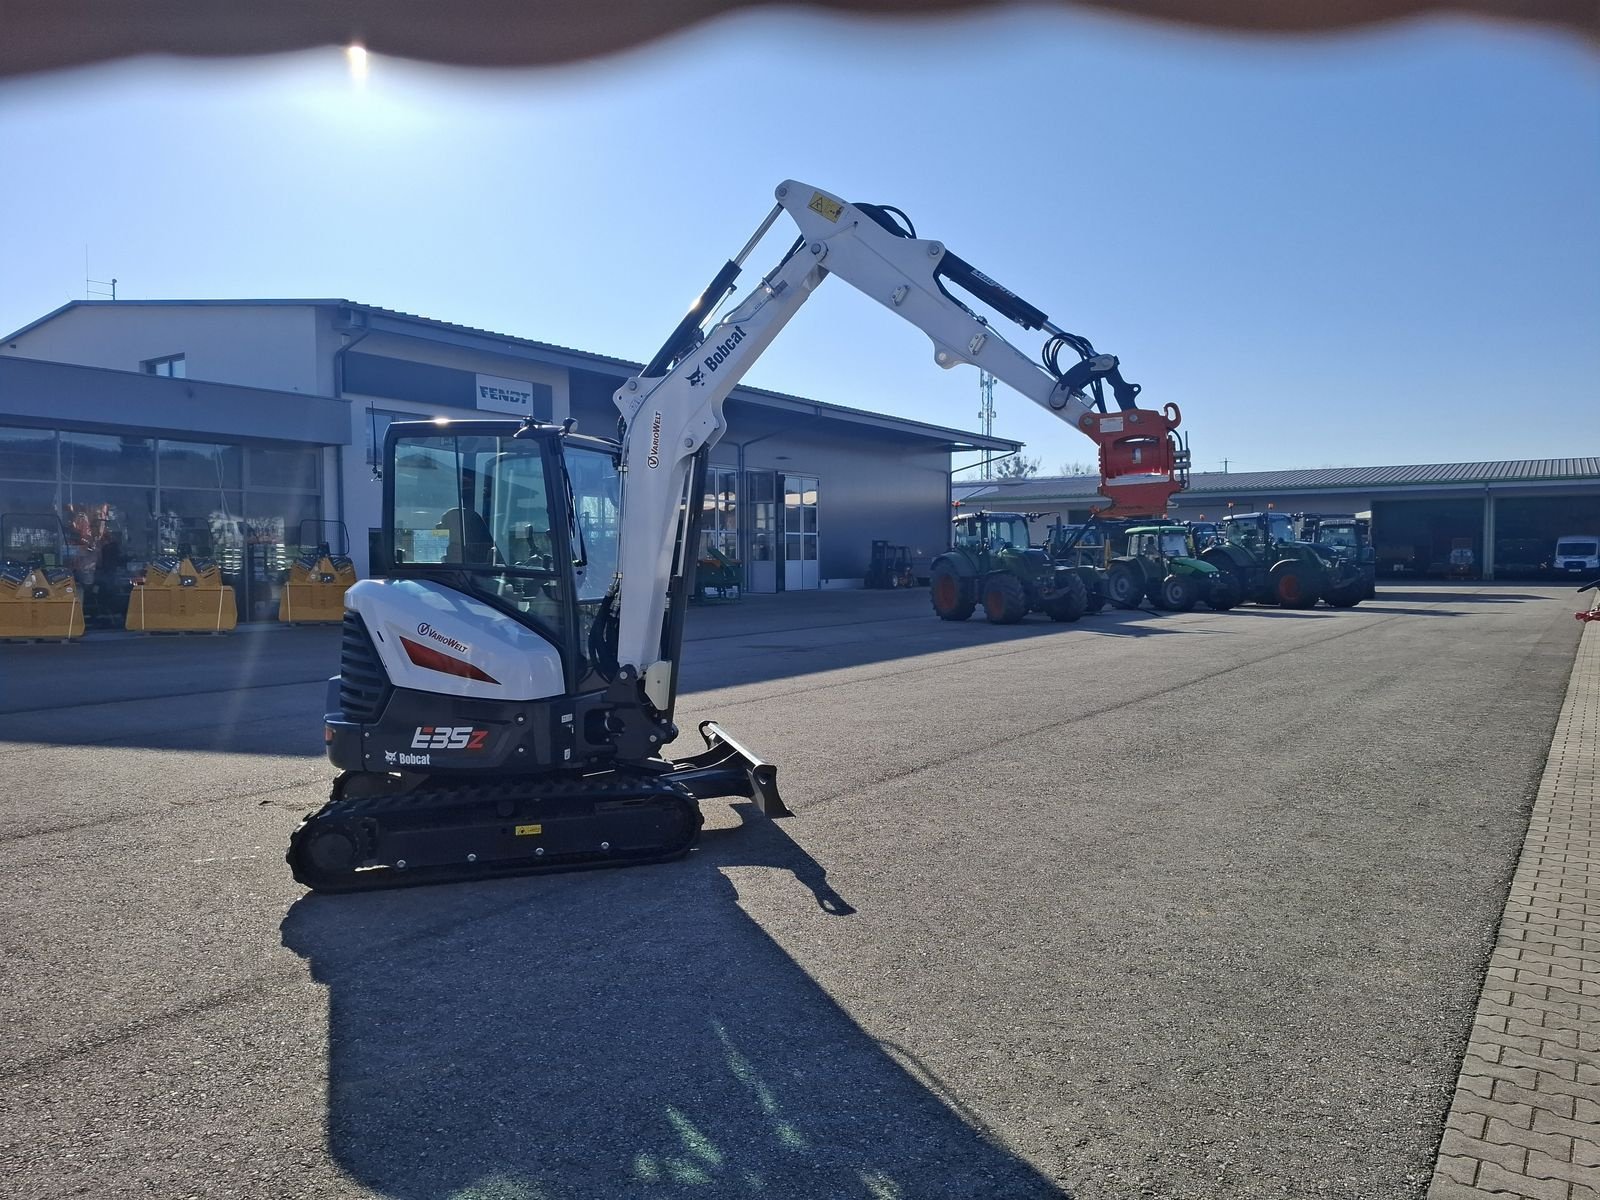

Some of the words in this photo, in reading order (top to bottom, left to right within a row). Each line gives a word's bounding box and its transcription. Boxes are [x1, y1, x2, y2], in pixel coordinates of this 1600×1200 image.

[704, 325, 747, 372] Bobcat
[480, 386, 530, 404] FENDT
[399, 753, 430, 765] Bobcat
